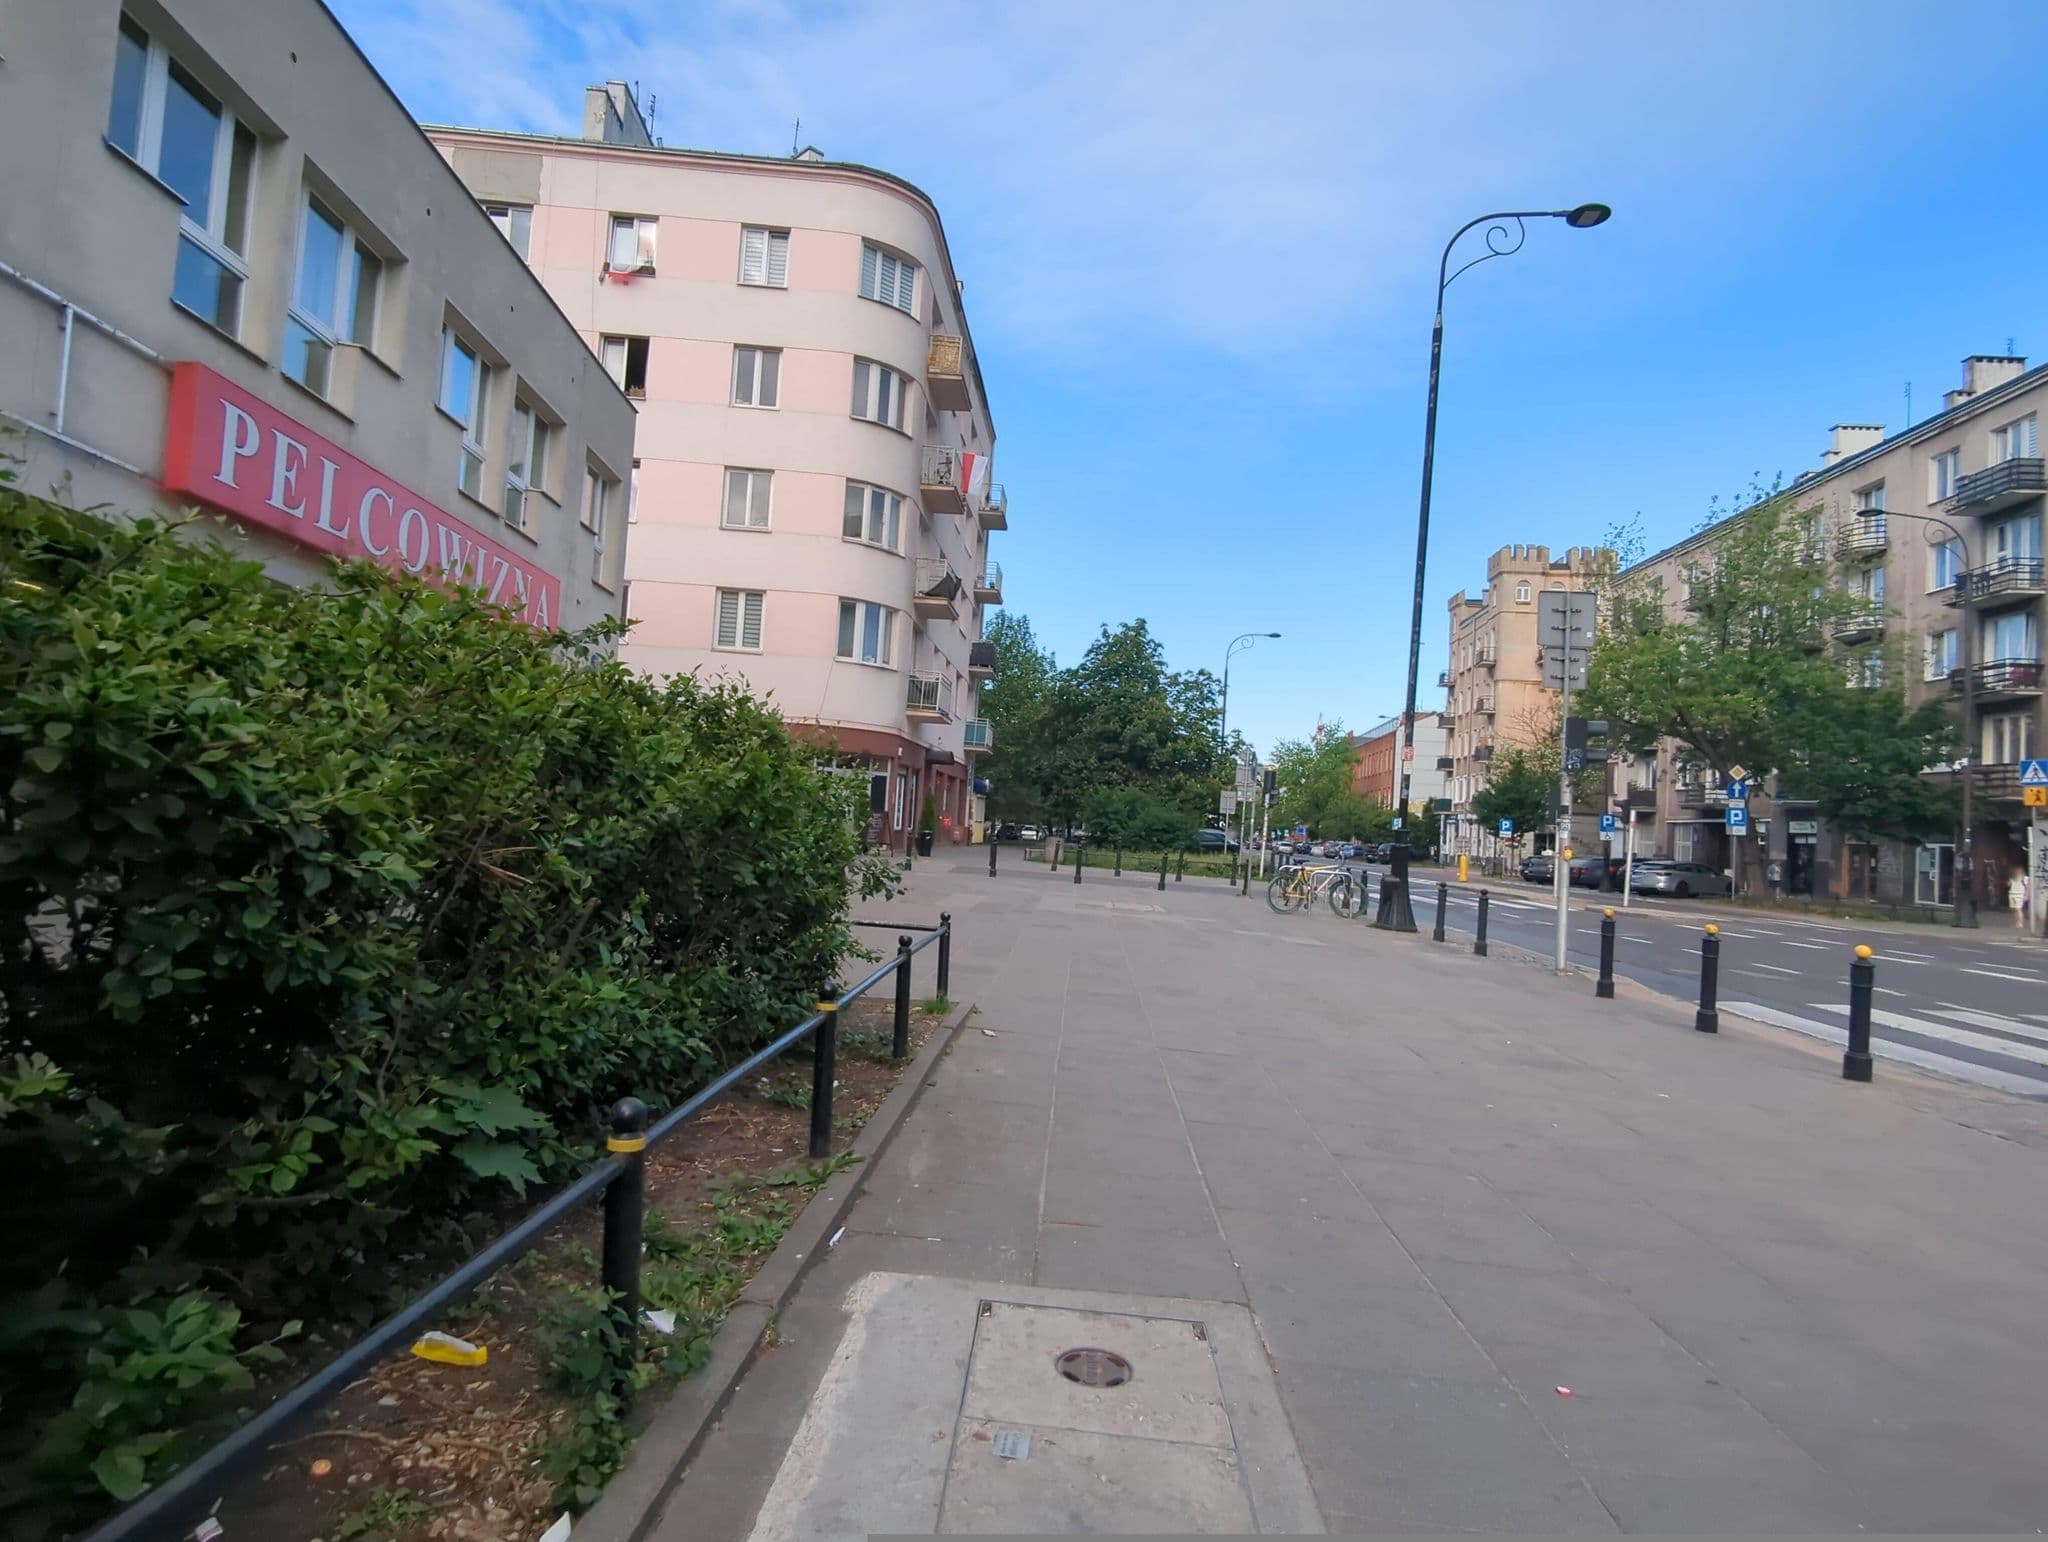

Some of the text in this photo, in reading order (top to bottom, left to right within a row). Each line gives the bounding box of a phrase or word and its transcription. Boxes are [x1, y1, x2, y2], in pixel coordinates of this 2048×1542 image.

[212, 398, 550, 632] PELCOWIZNA
[1603, 815, 1613, 827] P
[1730, 809, 1742, 824] P
[1502, 820, 1509, 830] P
